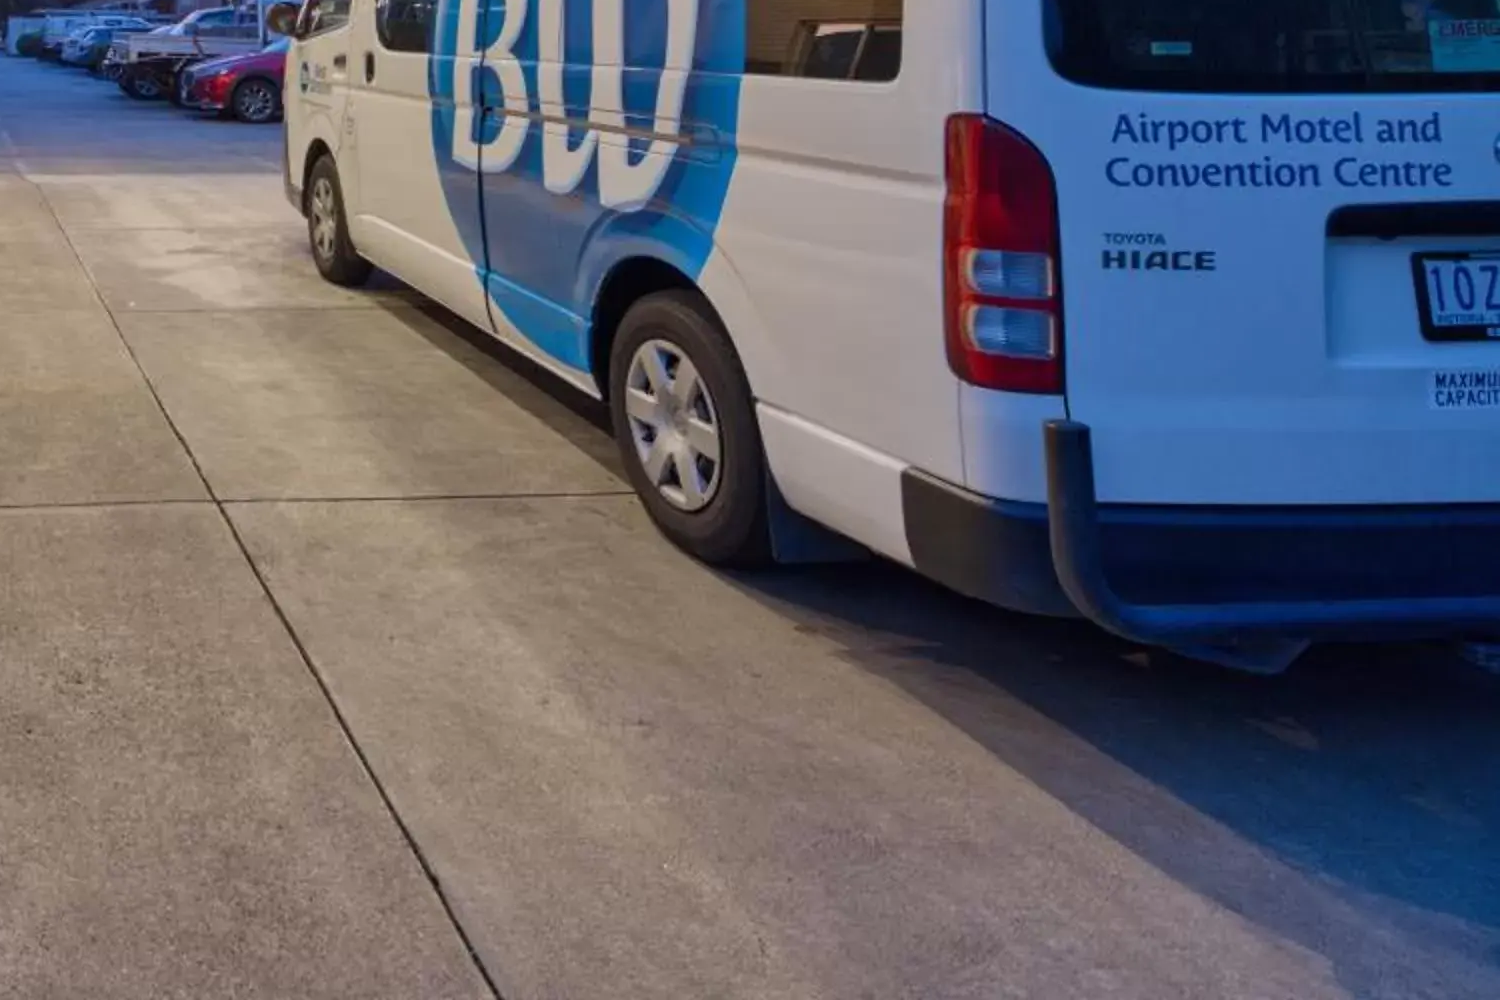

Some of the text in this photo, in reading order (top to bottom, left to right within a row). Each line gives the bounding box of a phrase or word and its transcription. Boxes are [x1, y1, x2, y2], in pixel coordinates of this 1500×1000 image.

[1111, 111, 1443, 150] Airport Motel and
[1105, 156, 1454, 188] Convention Centre
[1103, 233, 1167, 246] TOYOTA
[1101, 251, 1217, 272] HIACE
